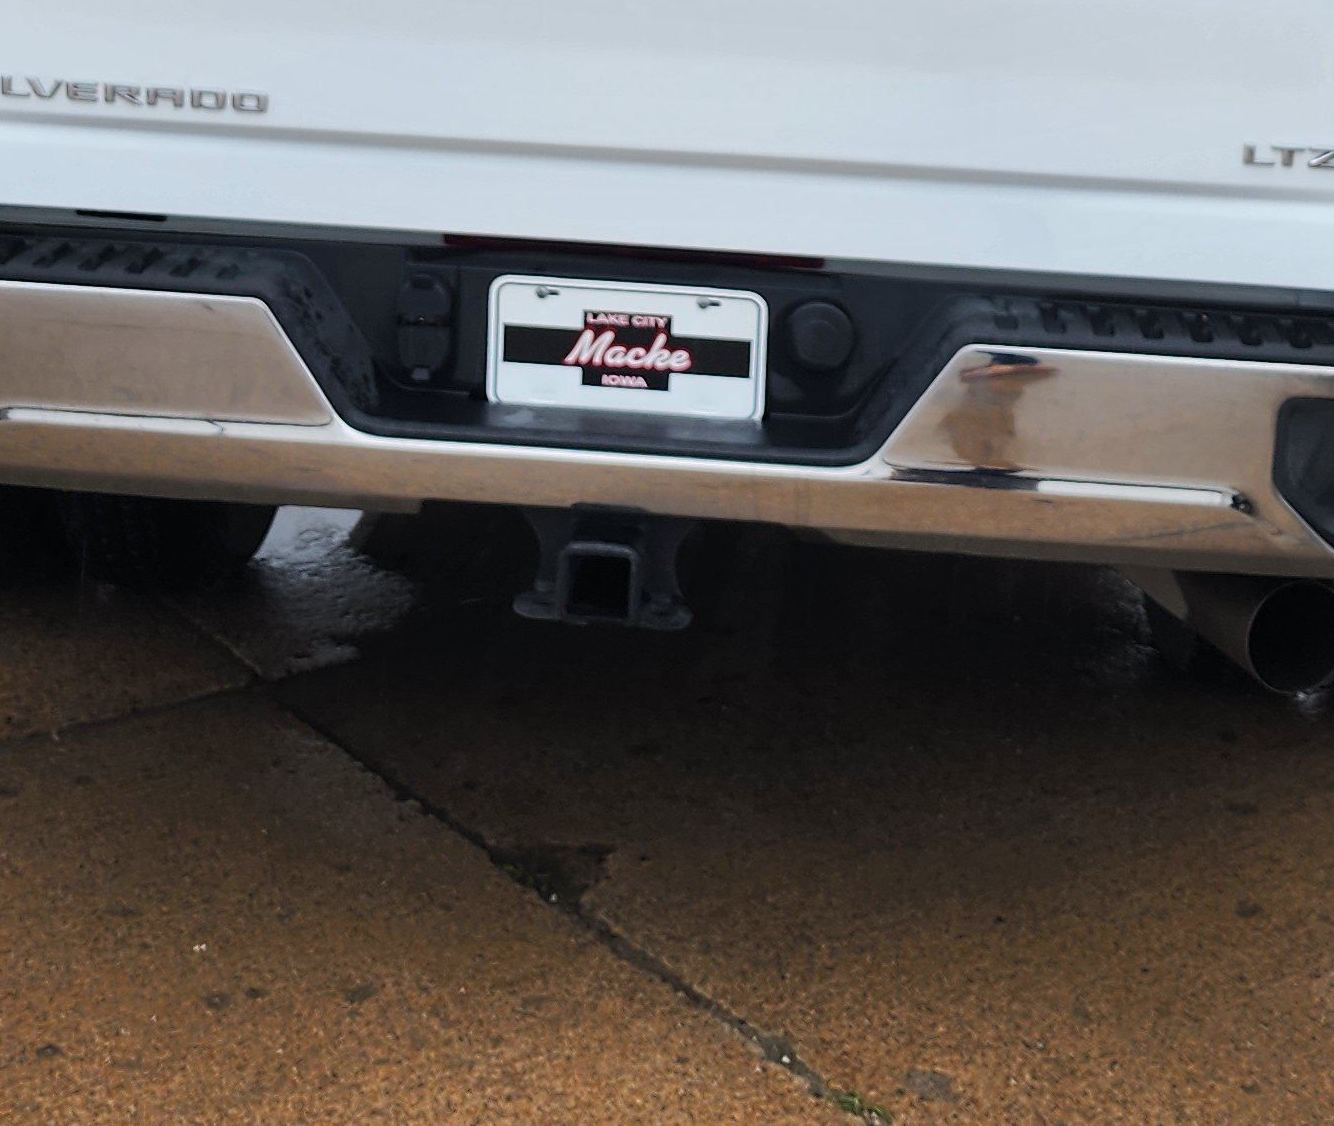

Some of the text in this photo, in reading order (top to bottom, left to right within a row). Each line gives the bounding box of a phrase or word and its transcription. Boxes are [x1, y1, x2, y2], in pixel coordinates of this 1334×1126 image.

[586, 312, 668, 329] LAKE CITY
[564, 329, 692, 371] Macke
[601, 374, 648, 388] IOWA
